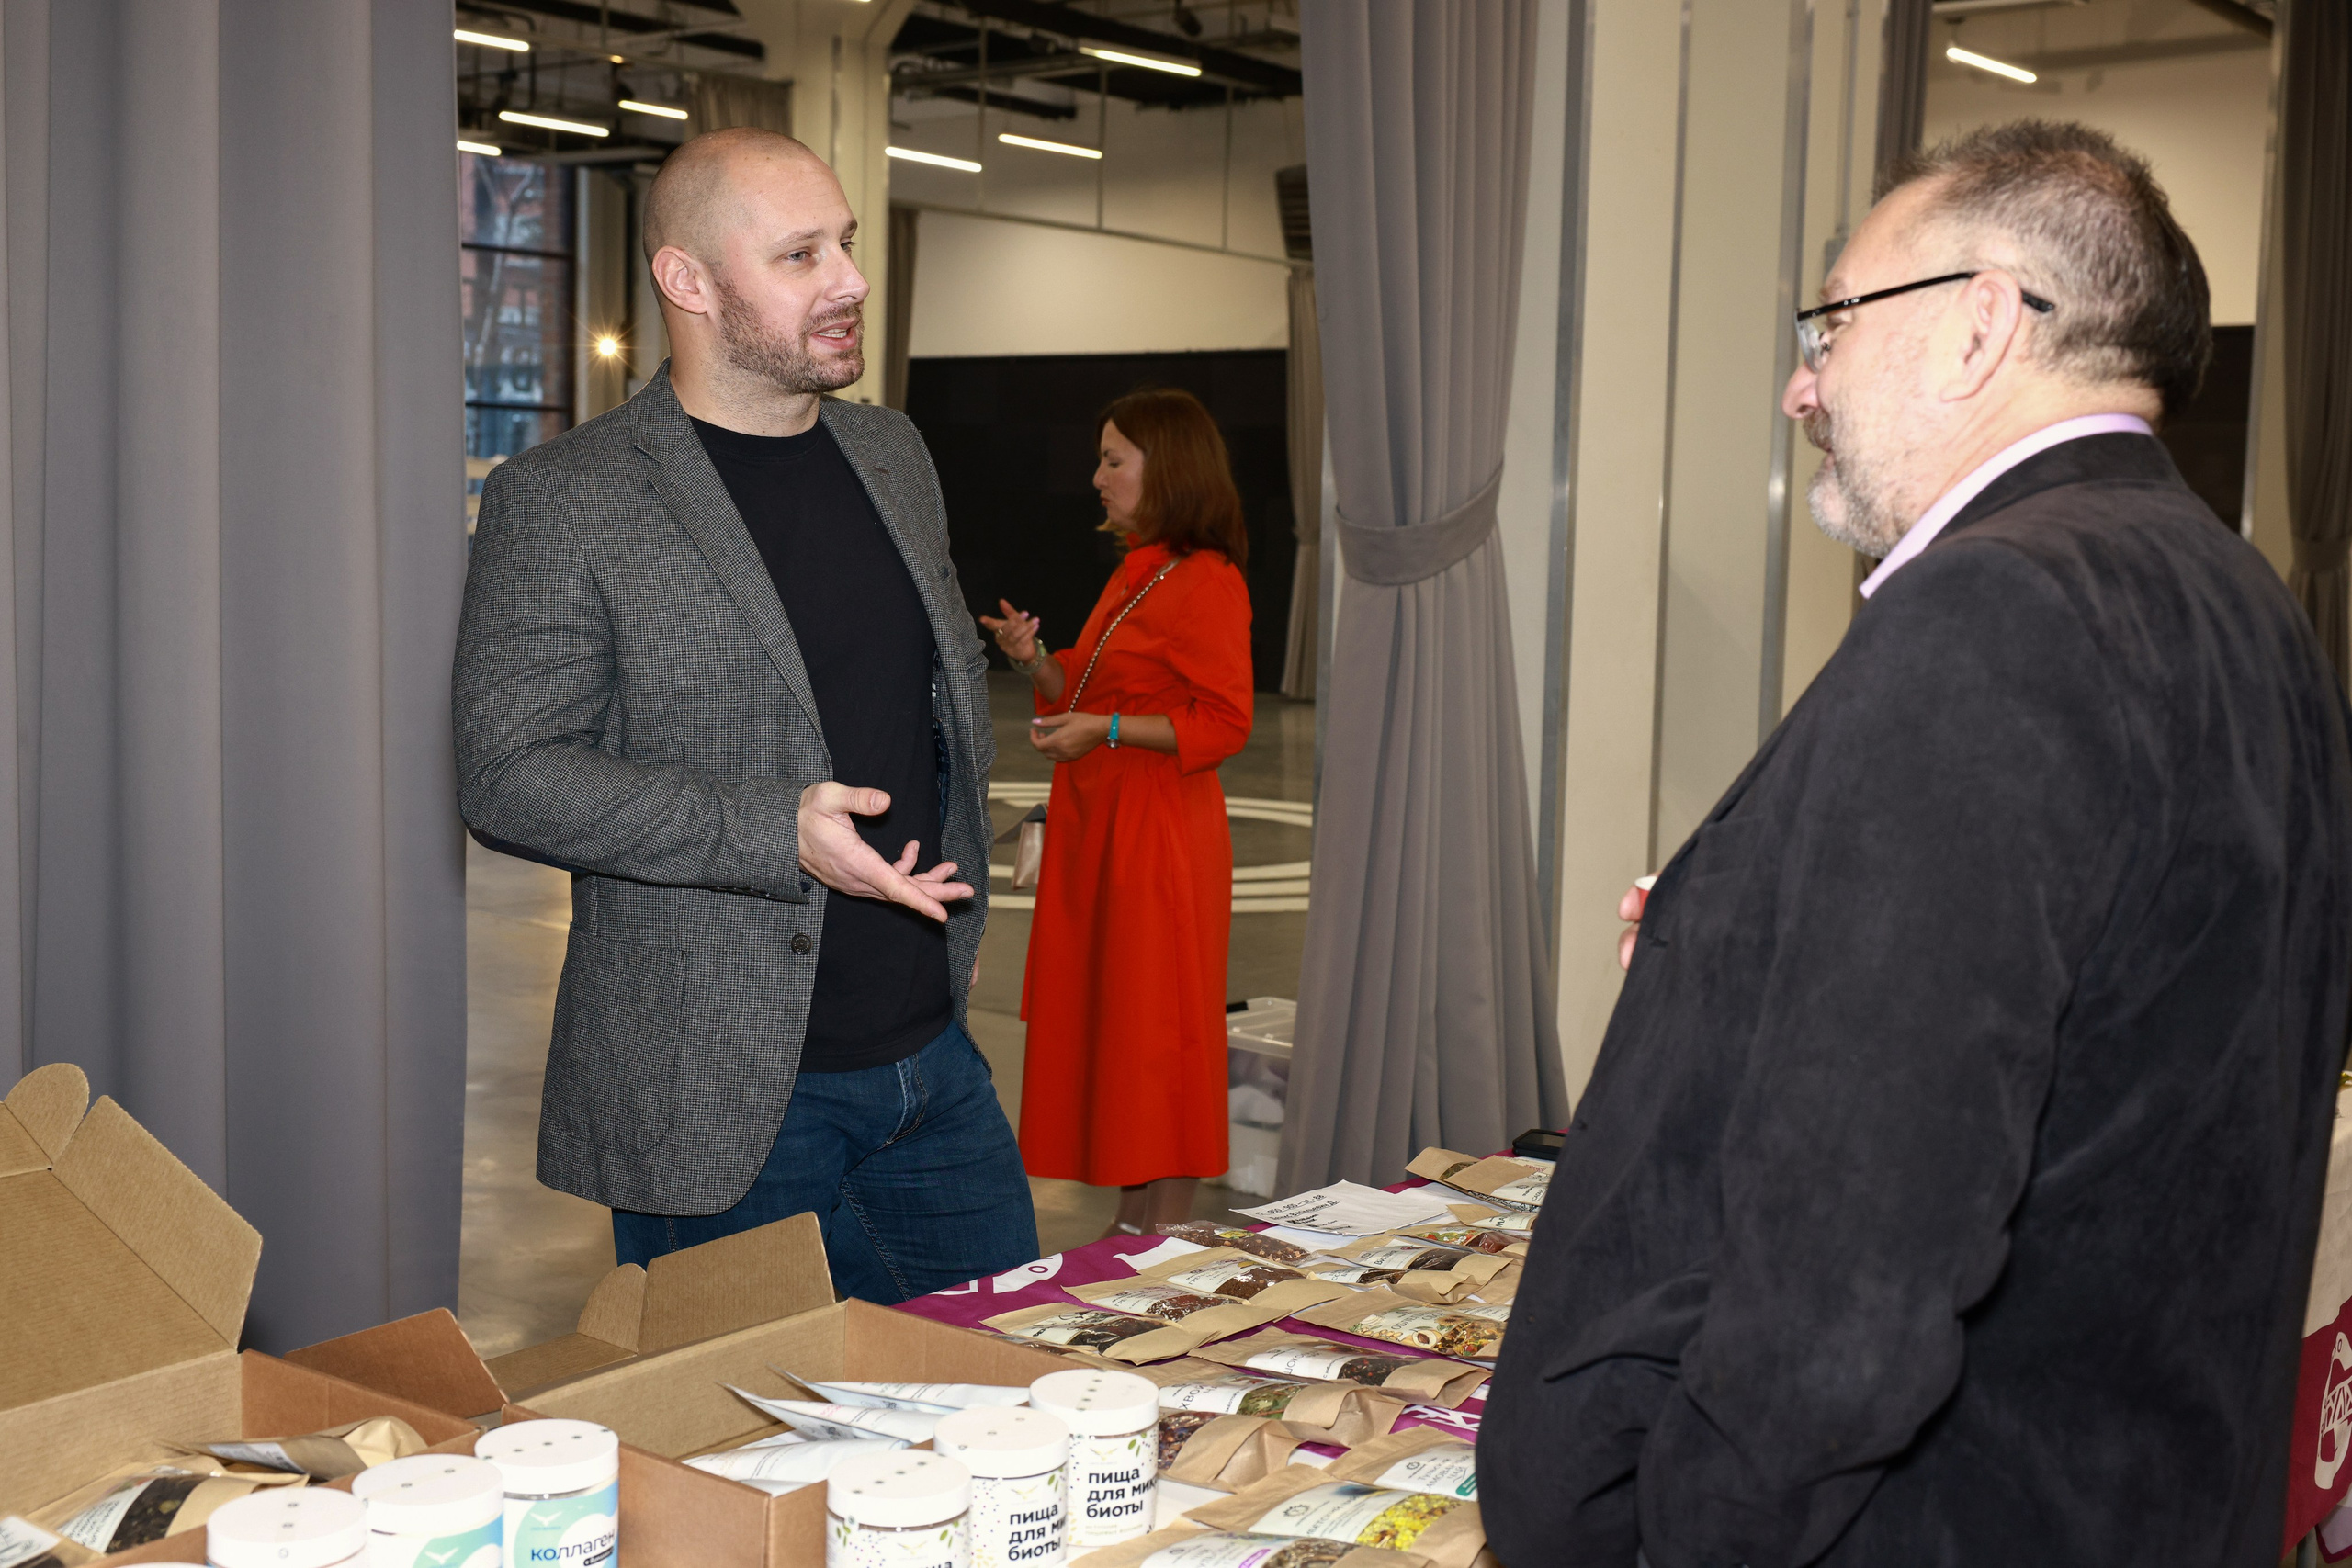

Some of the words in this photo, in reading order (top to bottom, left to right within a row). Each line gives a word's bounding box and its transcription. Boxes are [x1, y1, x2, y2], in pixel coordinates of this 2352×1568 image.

[1089, 1468, 1140, 1483] пища
[1087, 1488, 1125, 1503] для
[1010, 1504, 1058, 1525] пища
[1086, 1500, 1144, 1518] биоты
[530, 1528, 615, 1562] коллаген
[1008, 1526, 1046, 1545] для
[1008, 1536, 1061, 1561] биоты
